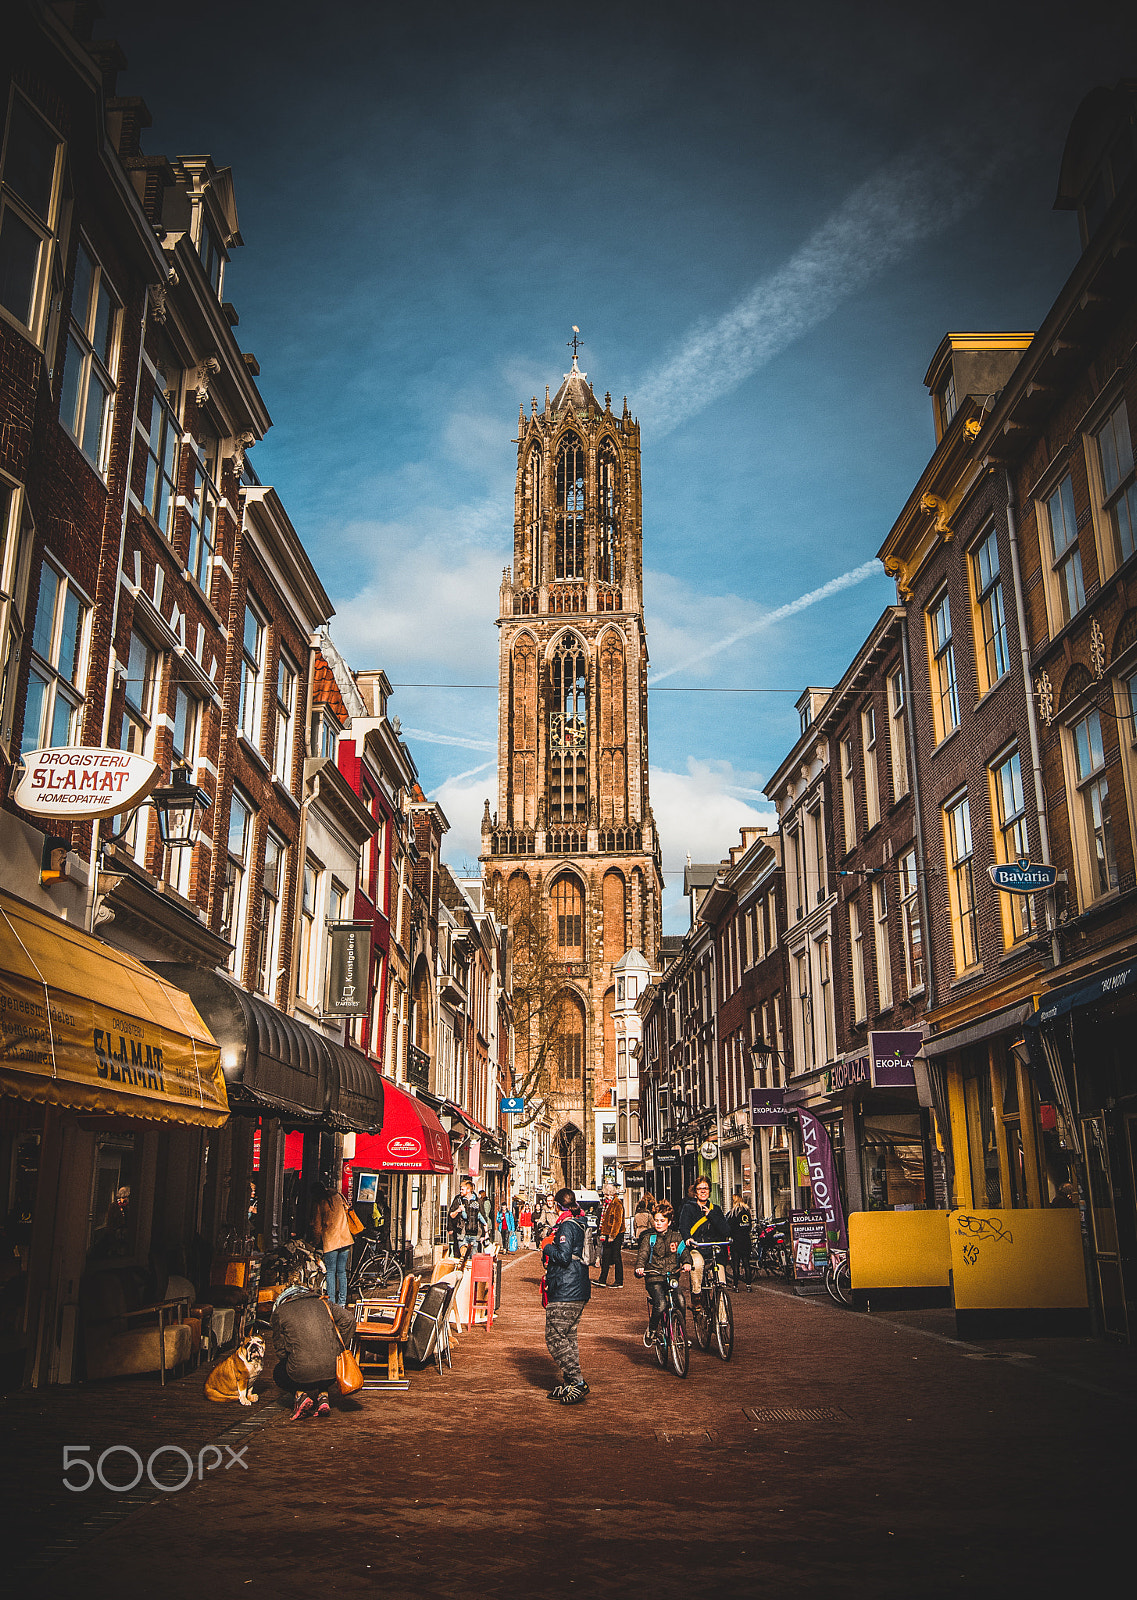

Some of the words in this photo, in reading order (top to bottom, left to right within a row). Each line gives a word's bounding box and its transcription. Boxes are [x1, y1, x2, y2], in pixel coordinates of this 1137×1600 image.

[39, 753, 131, 767] DROGISTERIJ
[31, 768, 130, 792] SLAMAT
[36, 793, 112, 805] HOMEOPATHIE
[999, 870, 1050, 883] Bavaria
[0, 995, 76, 1027] geneesmdelen
[1, 1020, 63, 1046] homeopatie
[112, 1017, 145, 1039] DROGISTERIJ
[93, 1028, 165, 1092] SLAMAT
[831, 1058, 866, 1091] EKOPLAZA
[792, 1215, 823, 1223] EKOPLAZA
